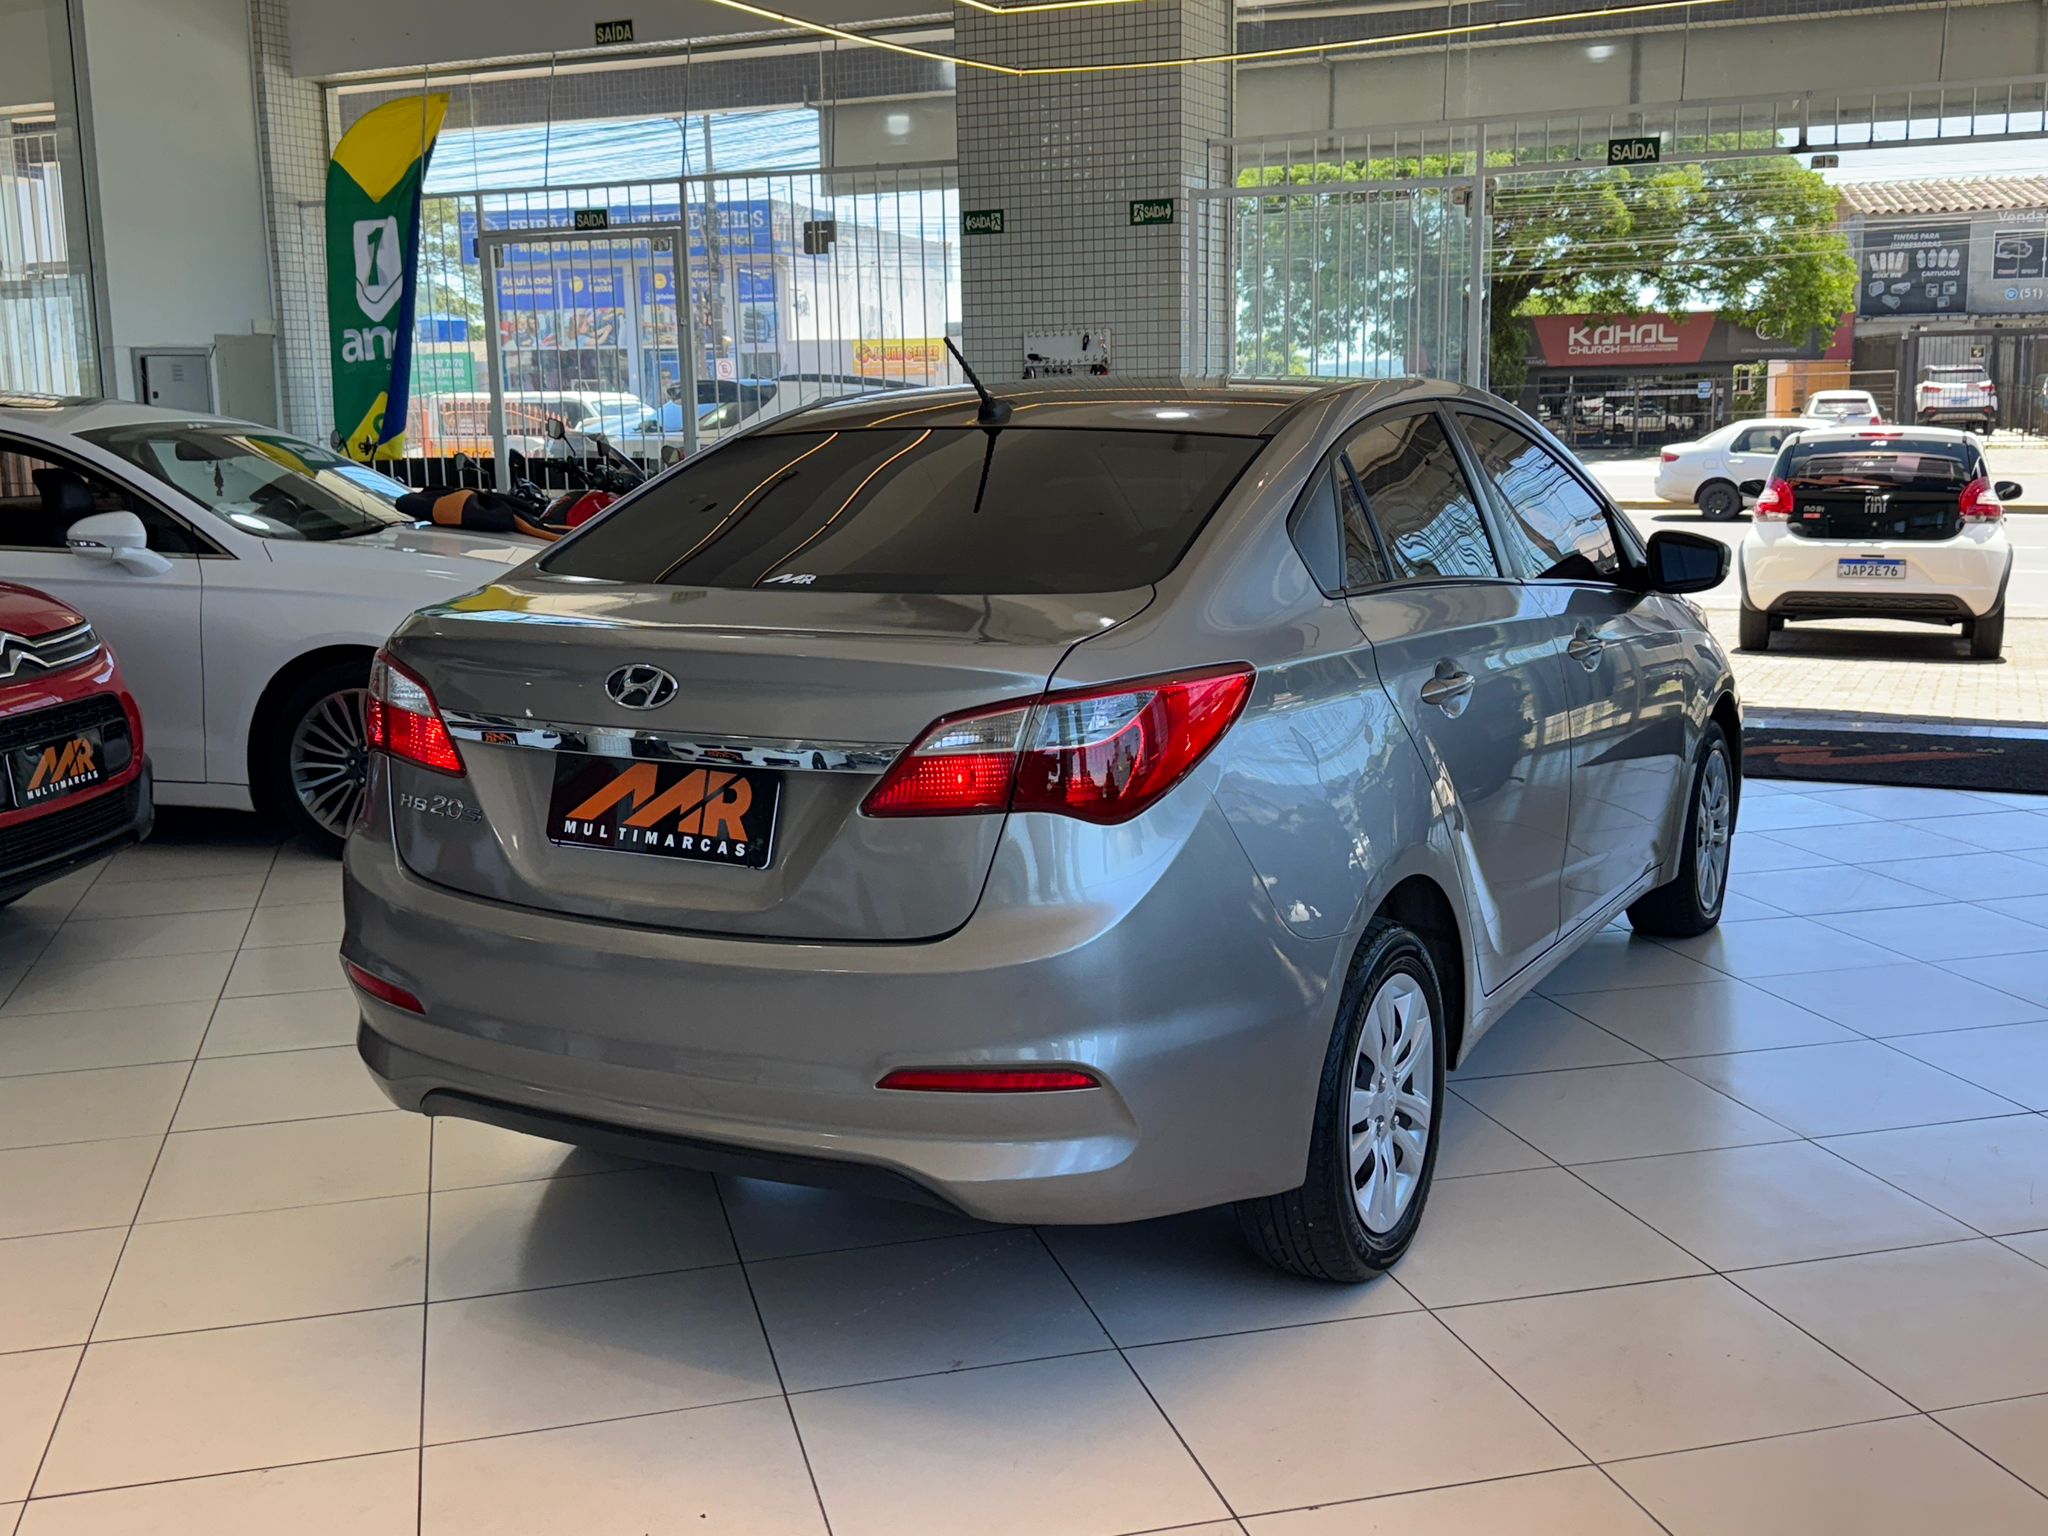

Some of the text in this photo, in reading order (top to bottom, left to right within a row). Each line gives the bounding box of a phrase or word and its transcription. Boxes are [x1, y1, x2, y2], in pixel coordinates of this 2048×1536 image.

[597, 23, 632, 42] SAÍDA
[1611, 140, 1656, 161] SAÍDA
[577, 211, 606, 227] SAÍDA
[1144, 204, 1166, 219] SAÍDA
[970, 213, 991, 228] SAÍDA
[1893, 232, 1940, 241] TINTAS PARA
[1921, 270, 1961, 278] CARTUCHOS
[2020, 288, 2043, 301] (51)
[1568, 323, 1679, 347] KAHAL
[341, 326, 398, 363] an
[1568, 344, 1620, 355] CHURCH
[1843, 565, 1899, 577] JAP2E76
[26, 769, 99, 801] MULTIMARCAS
[564, 819, 746, 858] MULTIMARCAS
